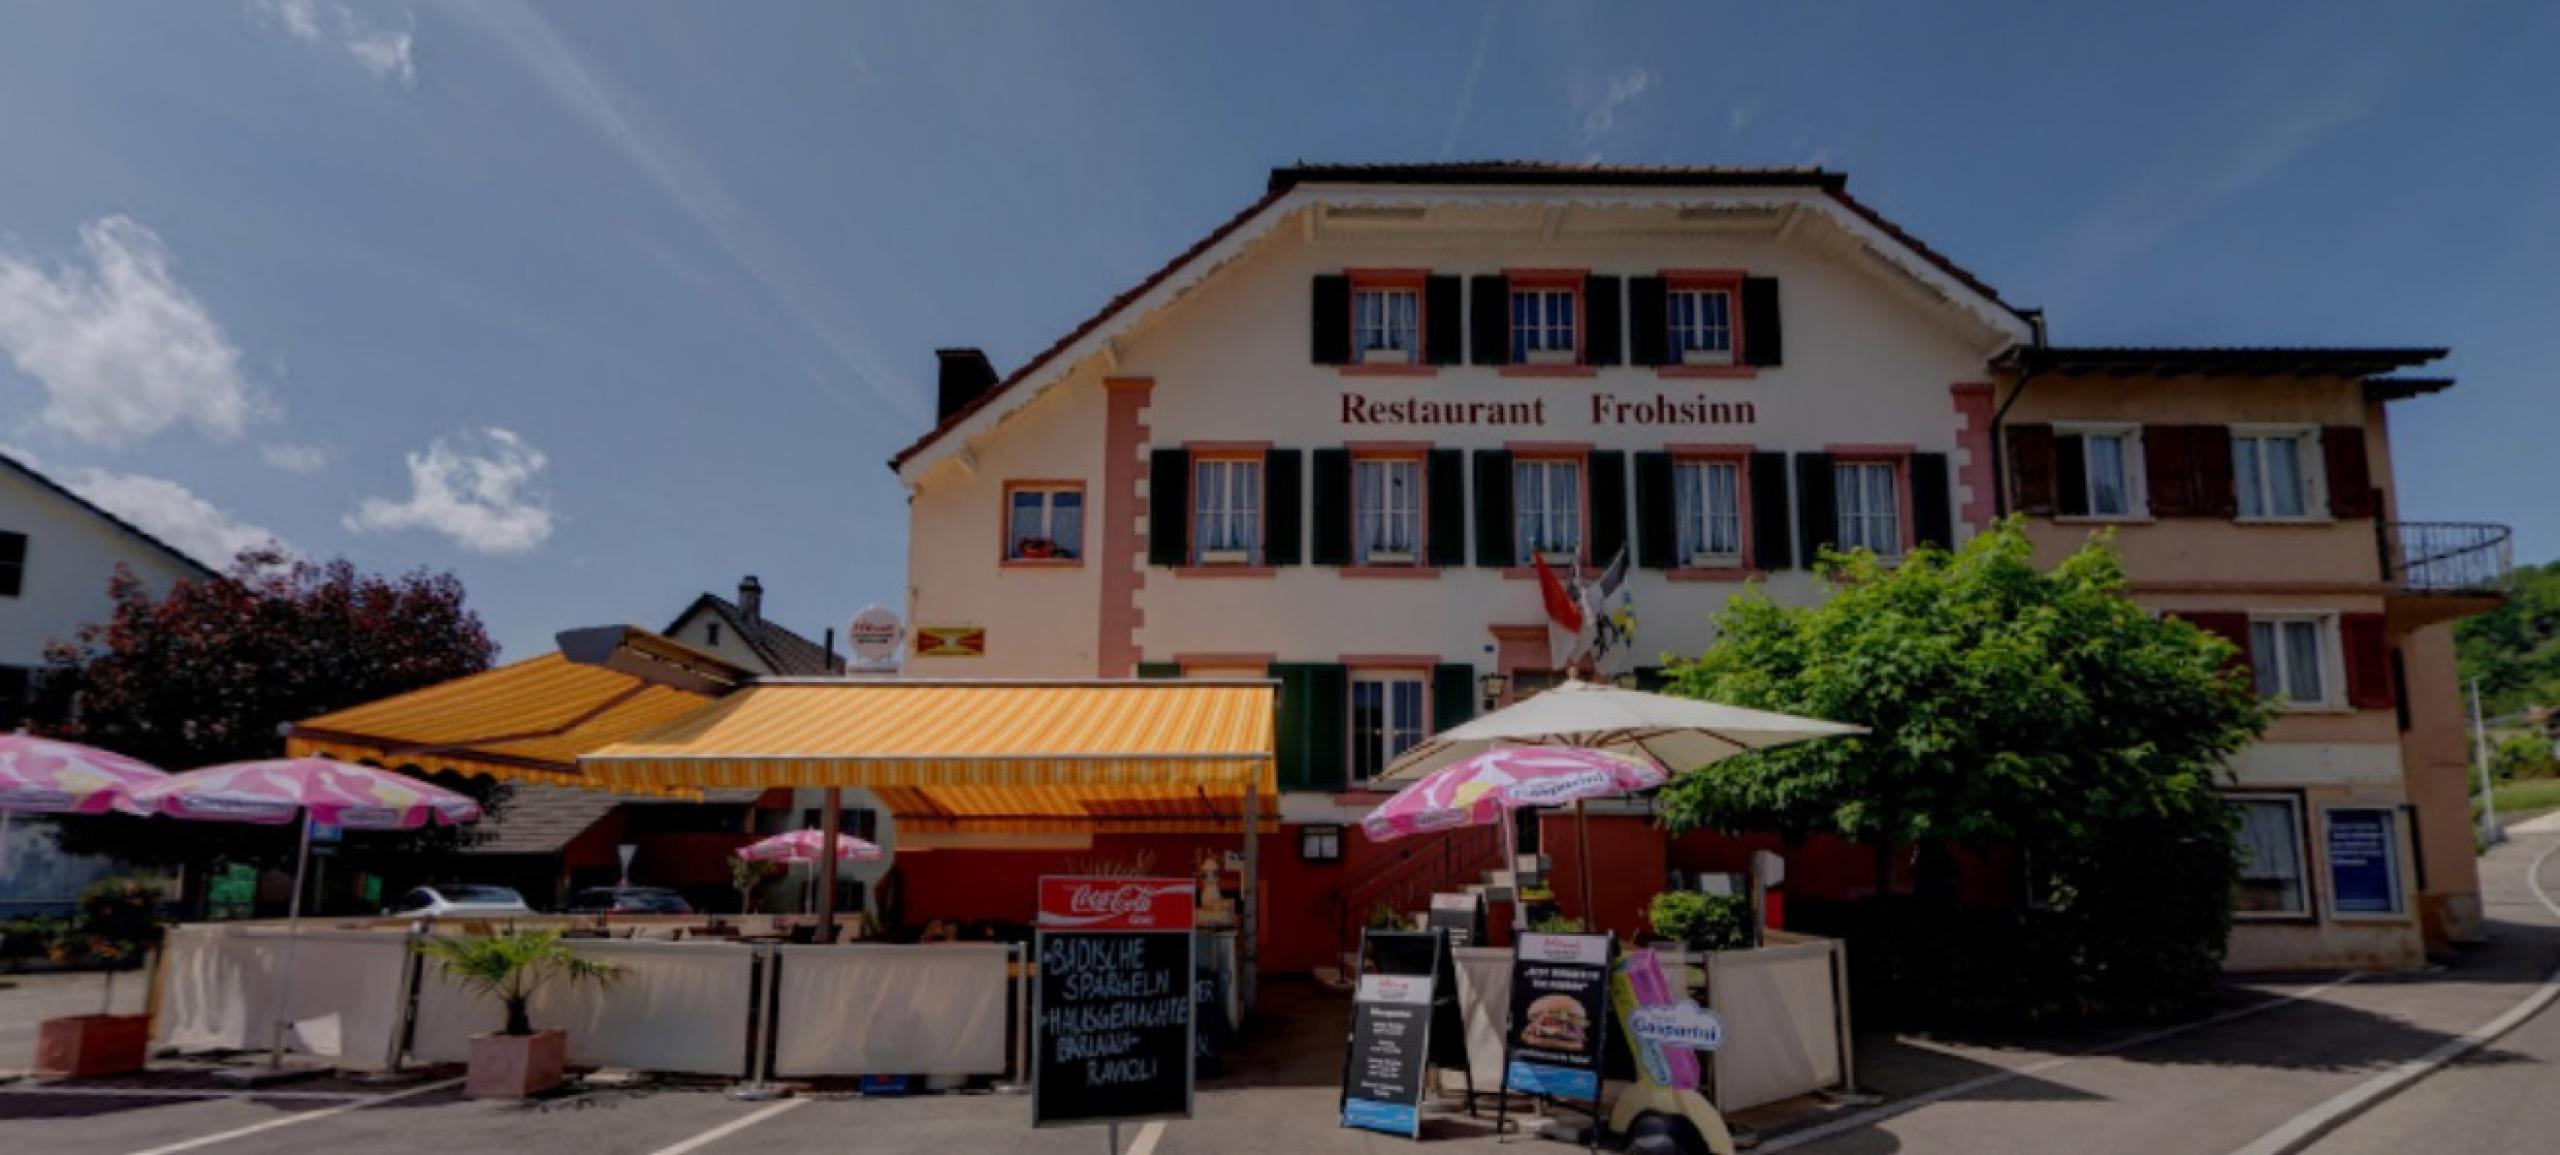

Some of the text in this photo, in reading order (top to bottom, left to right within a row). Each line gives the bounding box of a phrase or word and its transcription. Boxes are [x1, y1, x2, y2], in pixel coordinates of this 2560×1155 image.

[1340, 393, 1757, 425] Restaurant Frohsinn
[1070, 883, 1154, 915] Coca-Cola
